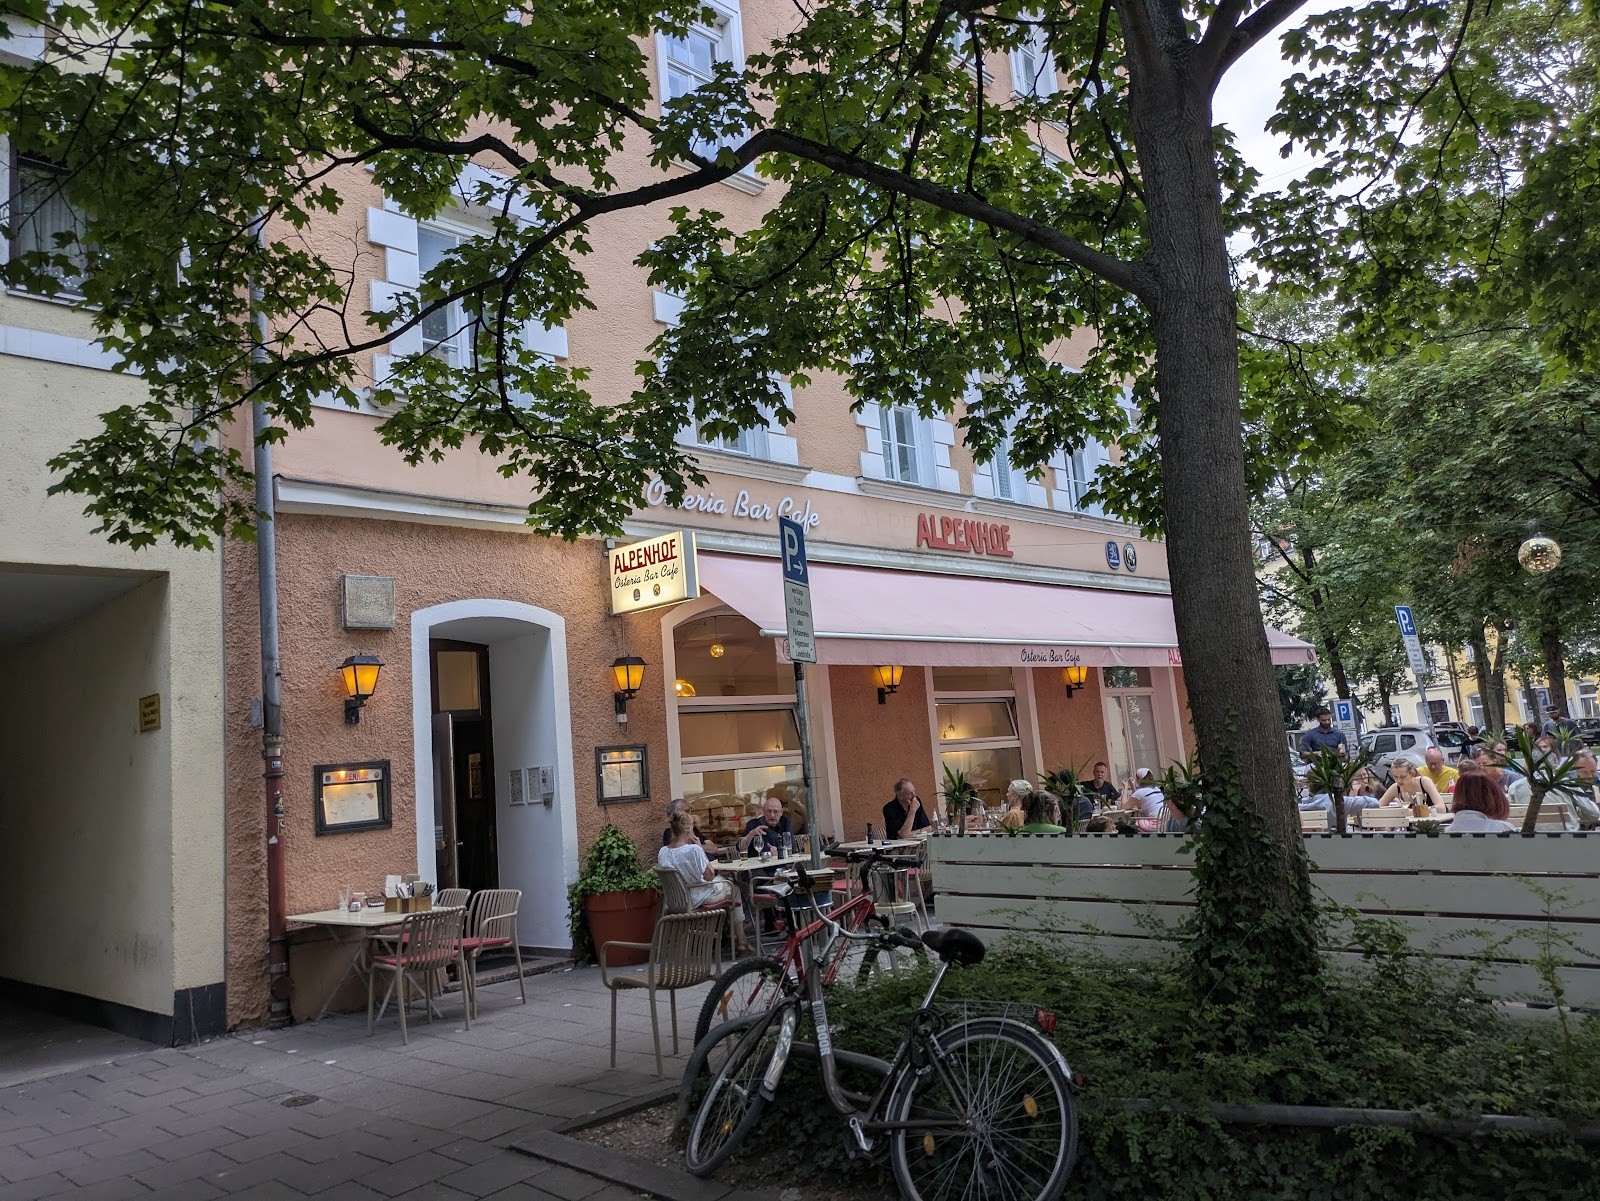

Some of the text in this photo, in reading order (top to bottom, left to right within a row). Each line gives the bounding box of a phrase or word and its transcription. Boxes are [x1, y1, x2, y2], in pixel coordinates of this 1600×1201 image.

[646, 474, 727, 514] Oeria
[733, 489, 773, 521] Bar
[783, 525, 799, 572] P
[916, 512, 1014, 558] ALPENHOF
[614, 538, 678, 575] ALPENHOF
[614, 562, 679, 589] Osteria Bar Cafe
[1398, 609, 1409, 633] P
[1020, 649, 1081, 666] Osteria Bar Cafe
[1339, 705, 1347, 719] P
